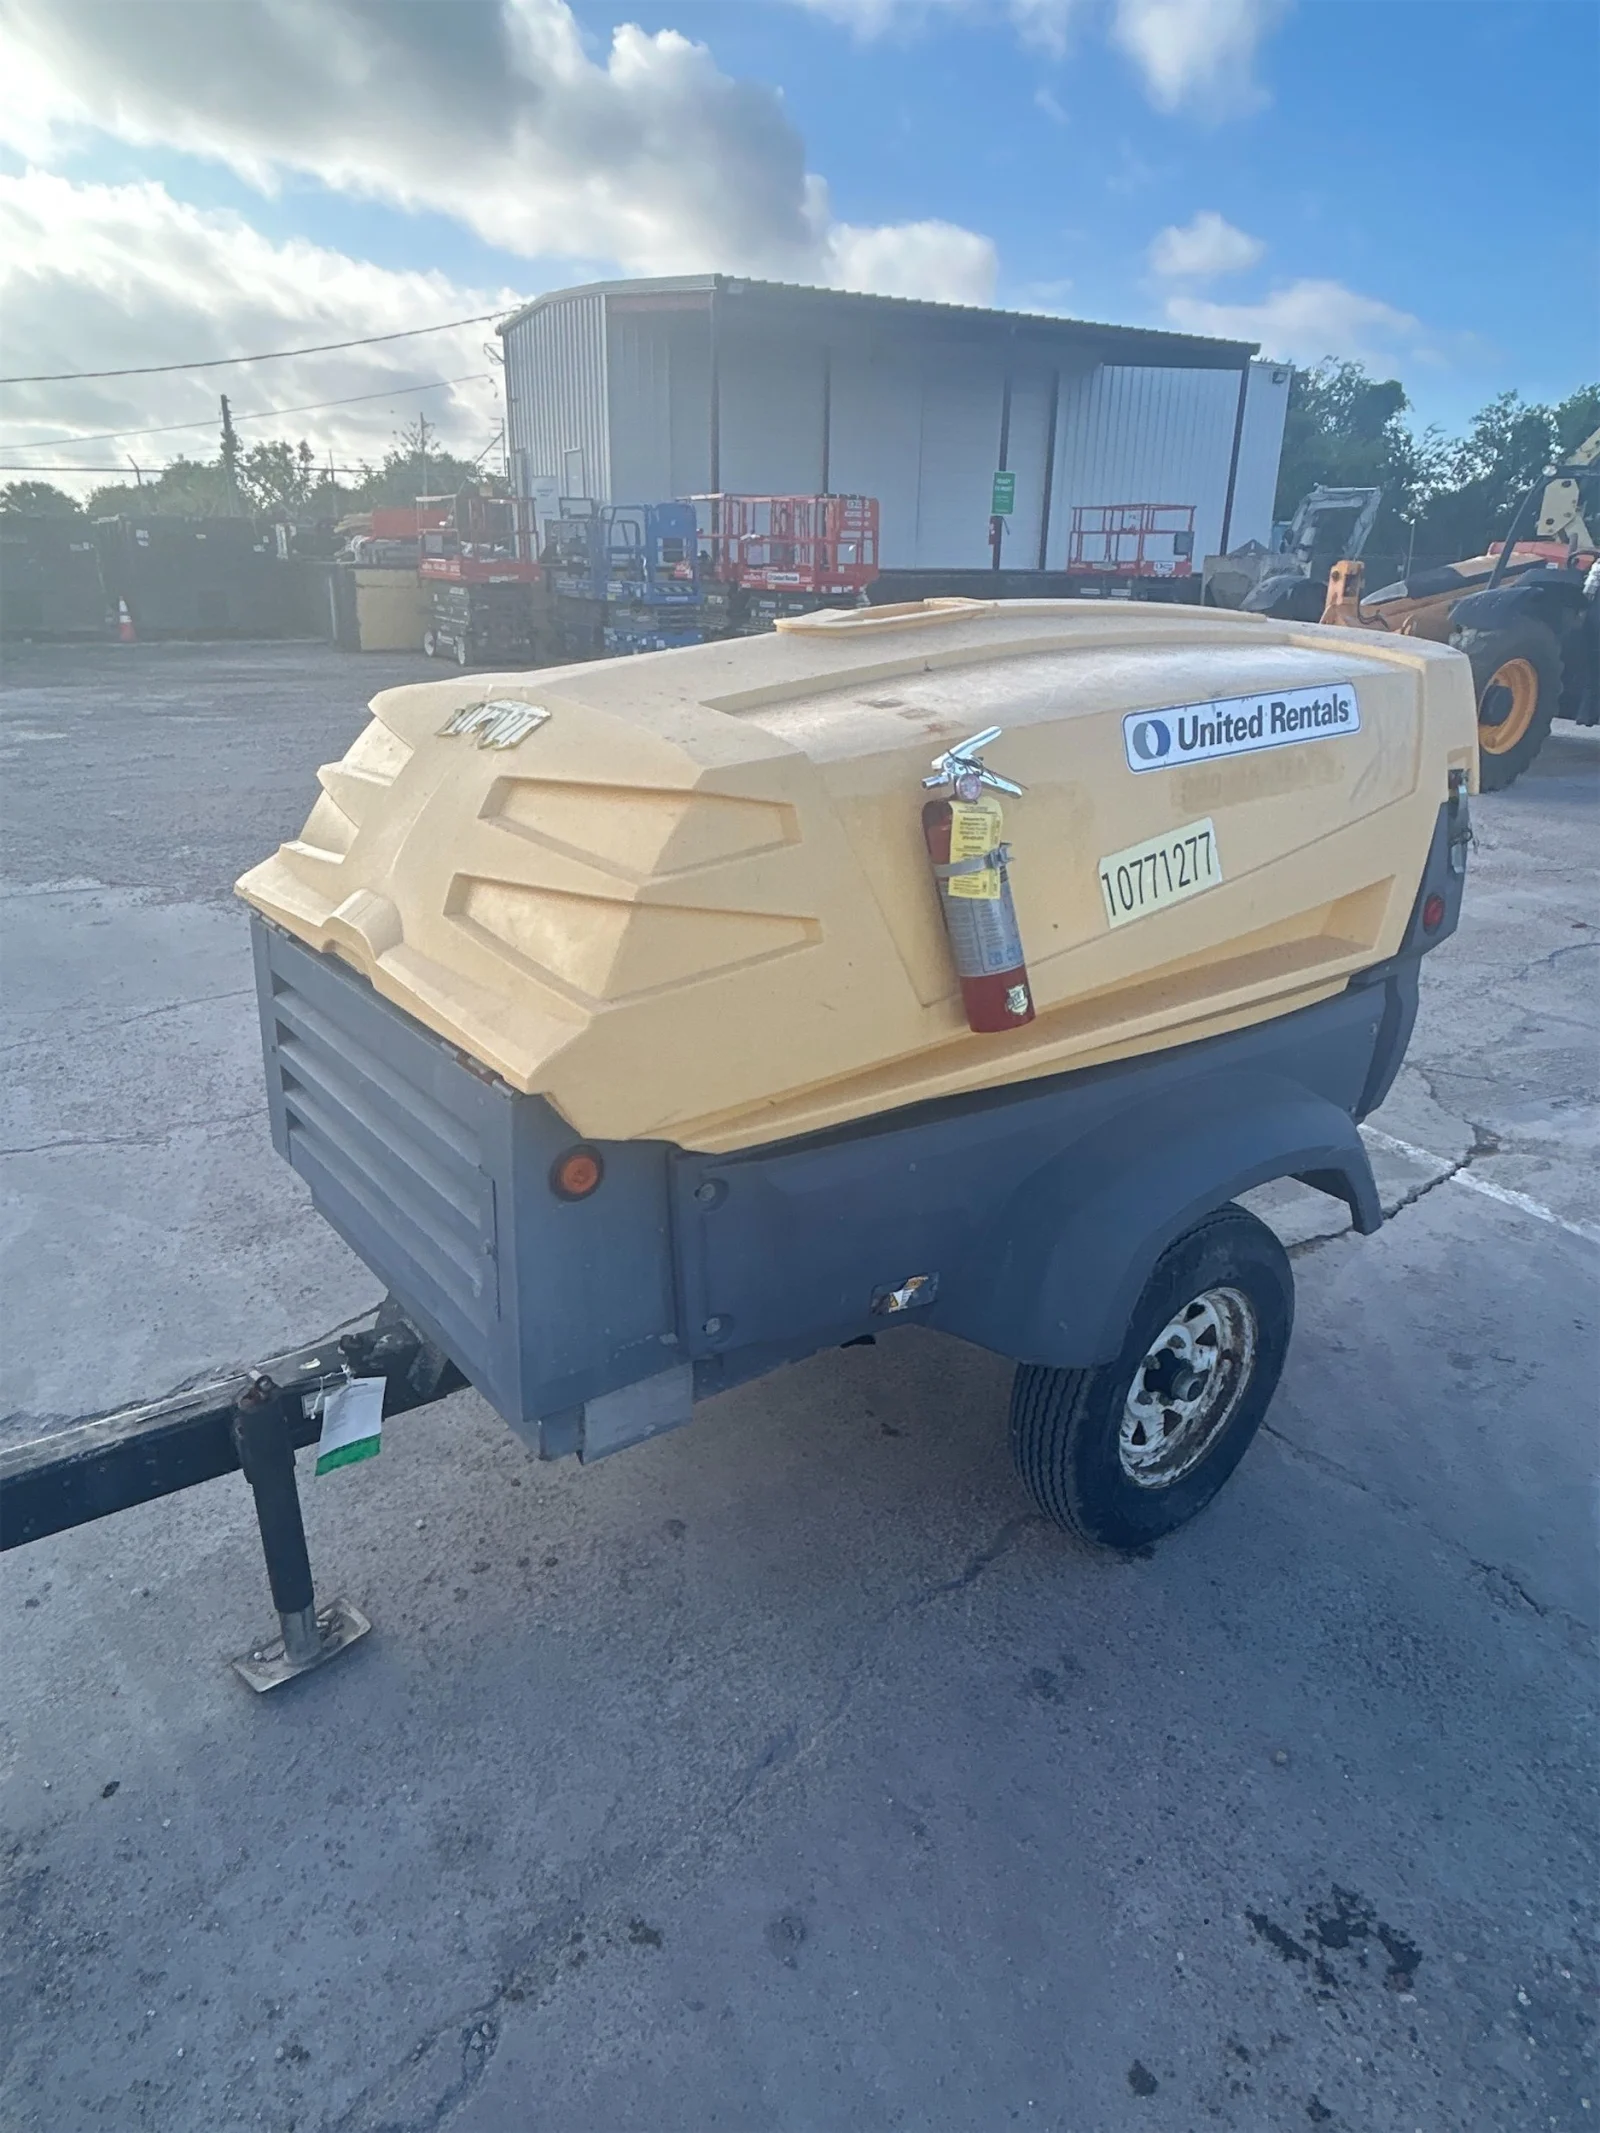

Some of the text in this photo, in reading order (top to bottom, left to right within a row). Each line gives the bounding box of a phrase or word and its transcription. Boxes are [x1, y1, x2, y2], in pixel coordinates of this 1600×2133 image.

[1178, 693, 1350, 751] United Rentals
[1101, 831, 1212, 917] 10771277
